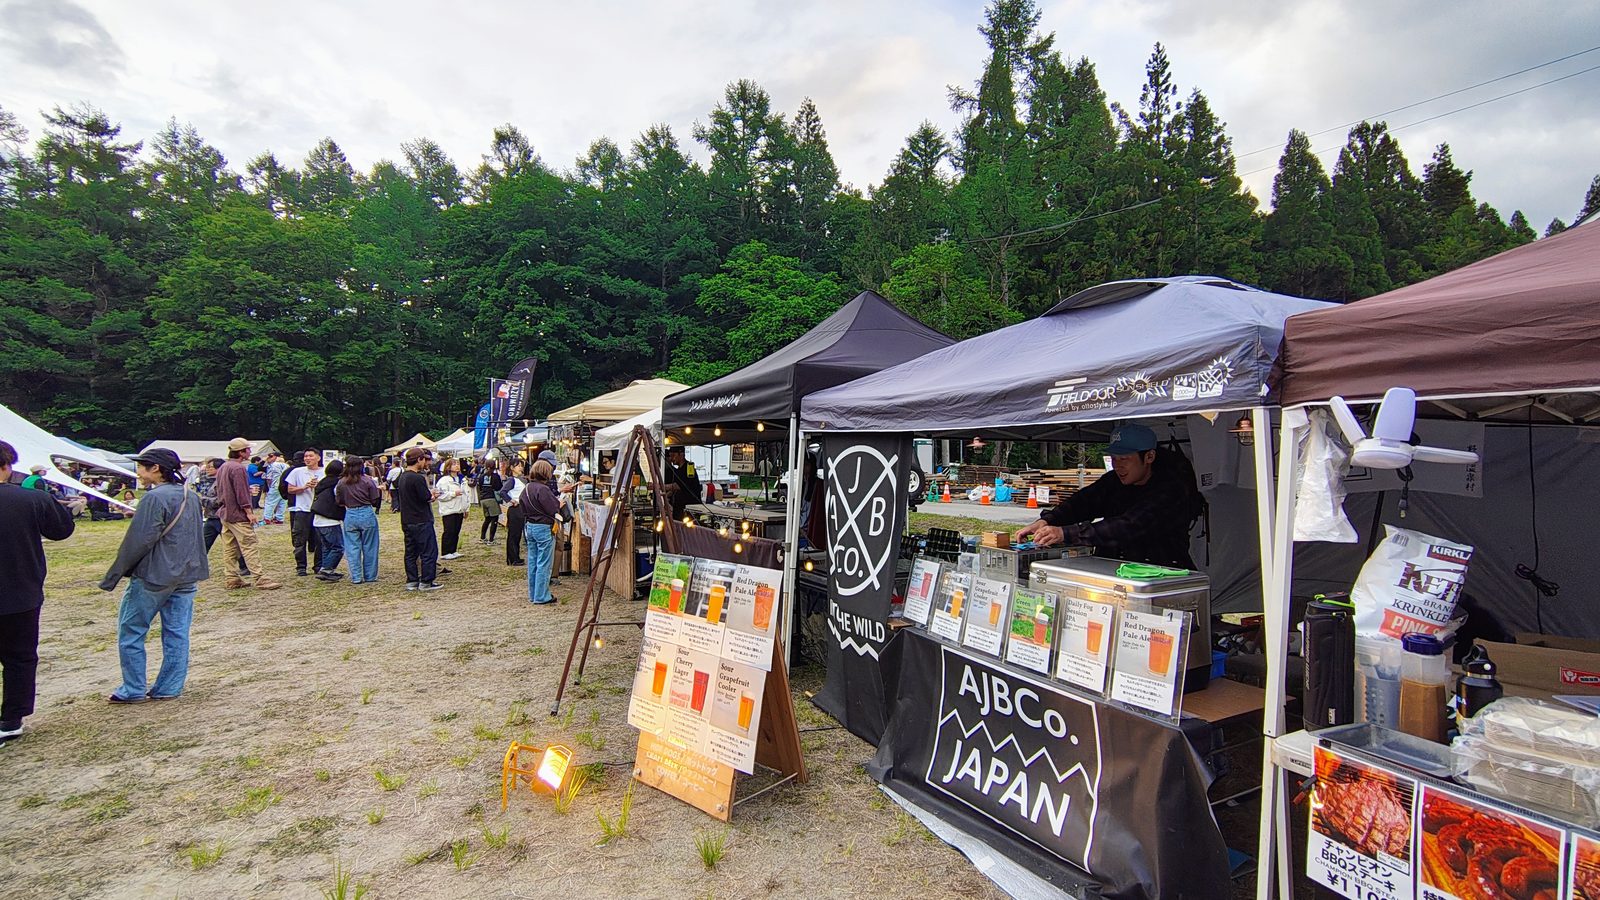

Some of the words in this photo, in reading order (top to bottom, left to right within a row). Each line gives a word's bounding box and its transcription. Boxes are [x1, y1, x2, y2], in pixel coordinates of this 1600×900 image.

[1200, 383, 1214, 393] UV
[1044, 403, 1071, 413] Powered
[1073, 401, 1081, 412] by
[1083, 399, 1119, 410] ottostyle.jp
[847, 456, 862, 494] J
[868, 496, 887, 537] B
[739, 567, 749, 575] The
[736, 577, 747, 585] Red
[748, 579, 769, 589] Dragon
[734, 586, 747, 595] Pale
[974, 586, 999, 597] Grapefruit
[973, 593, 988, 601] Cooler
[1015, 598, 1031, 607] Green
[1068, 599, 1082, 609] Daily
[1083, 602, 1093, 611] Fog
[1101, 606, 1108, 616] 2
[1066, 614, 1076, 622] IPA
[1067, 608, 1088, 617] Session
[1125, 612, 1138, 620] The
[1167, 611, 1174, 622] 1
[852, 614, 885, 643] WILD
[1124, 621, 1138, 630] Red
[1138, 624, 1165, 636] Dragon
[1122, 630, 1138, 640] Pale
[1139, 634, 1150, 642] Ale
[677, 648, 689, 657] Sour
[676, 657, 693, 669] Cherry
[721, 662, 734, 673] Sour
[674, 666, 689, 677] Lager
[719, 672, 750, 688] Grapefruit
[718, 682, 737, 693] Cooler
[958, 664, 1079, 745] AJBCo.
[942, 739, 1071, 837] JAPAN
[1324, 839, 1392, 877] チャンピオン
[1314, 856, 1353, 880] CHAMPION
[1355, 877, 1374, 891] BBQ
[1321, 848, 1396, 893] BBQステーキ
[1326, 869, 1388, 900] ¥110
